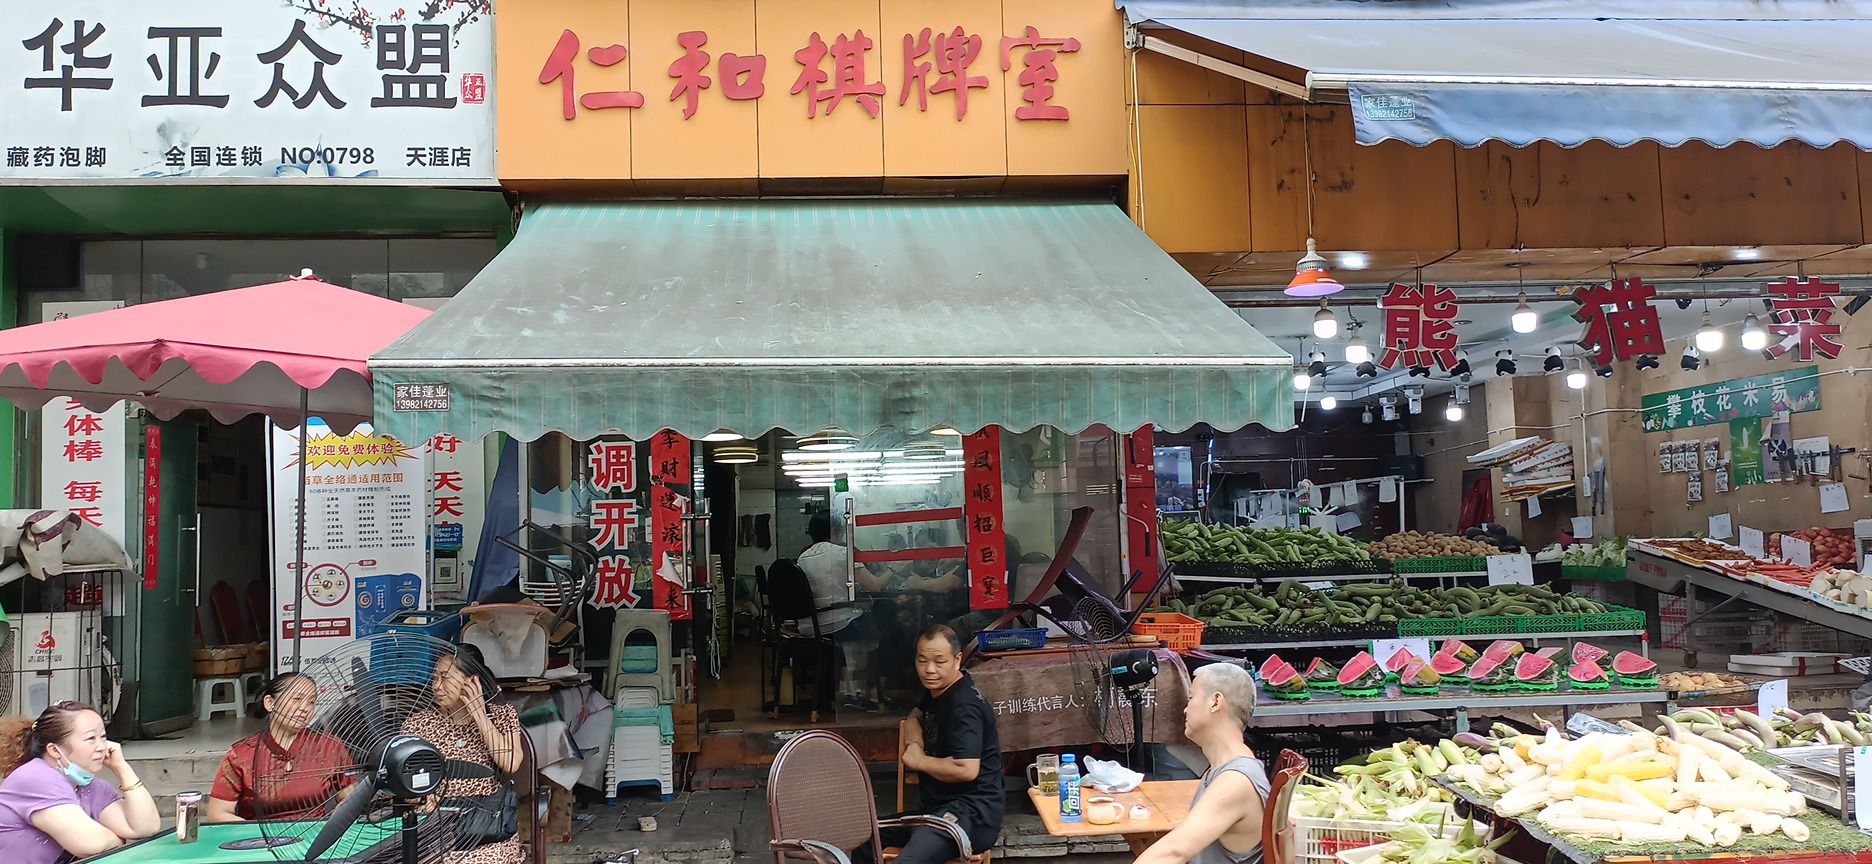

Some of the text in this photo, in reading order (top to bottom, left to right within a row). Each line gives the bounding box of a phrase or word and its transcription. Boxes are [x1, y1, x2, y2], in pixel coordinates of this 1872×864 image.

[22, 17, 457, 112] 华亚众盟
[538, 25, 1080, 121] 仁和棋牌室
[7, 145, 107, 168] 藏药泡脚
[165, 145, 264, 168] 全国连锁
[406, 146, 472, 168] 天涯店
[1377, 276, 1845, 371] 熊猫菜
[396, 399, 447, 409] 13982142756
[1666, 376, 1788, 418] 攀枝花米易
[63, 399, 104, 462] 体棒
[307, 443, 395, 456] 欢迎免费体验
[427, 471, 464, 526] 天天
